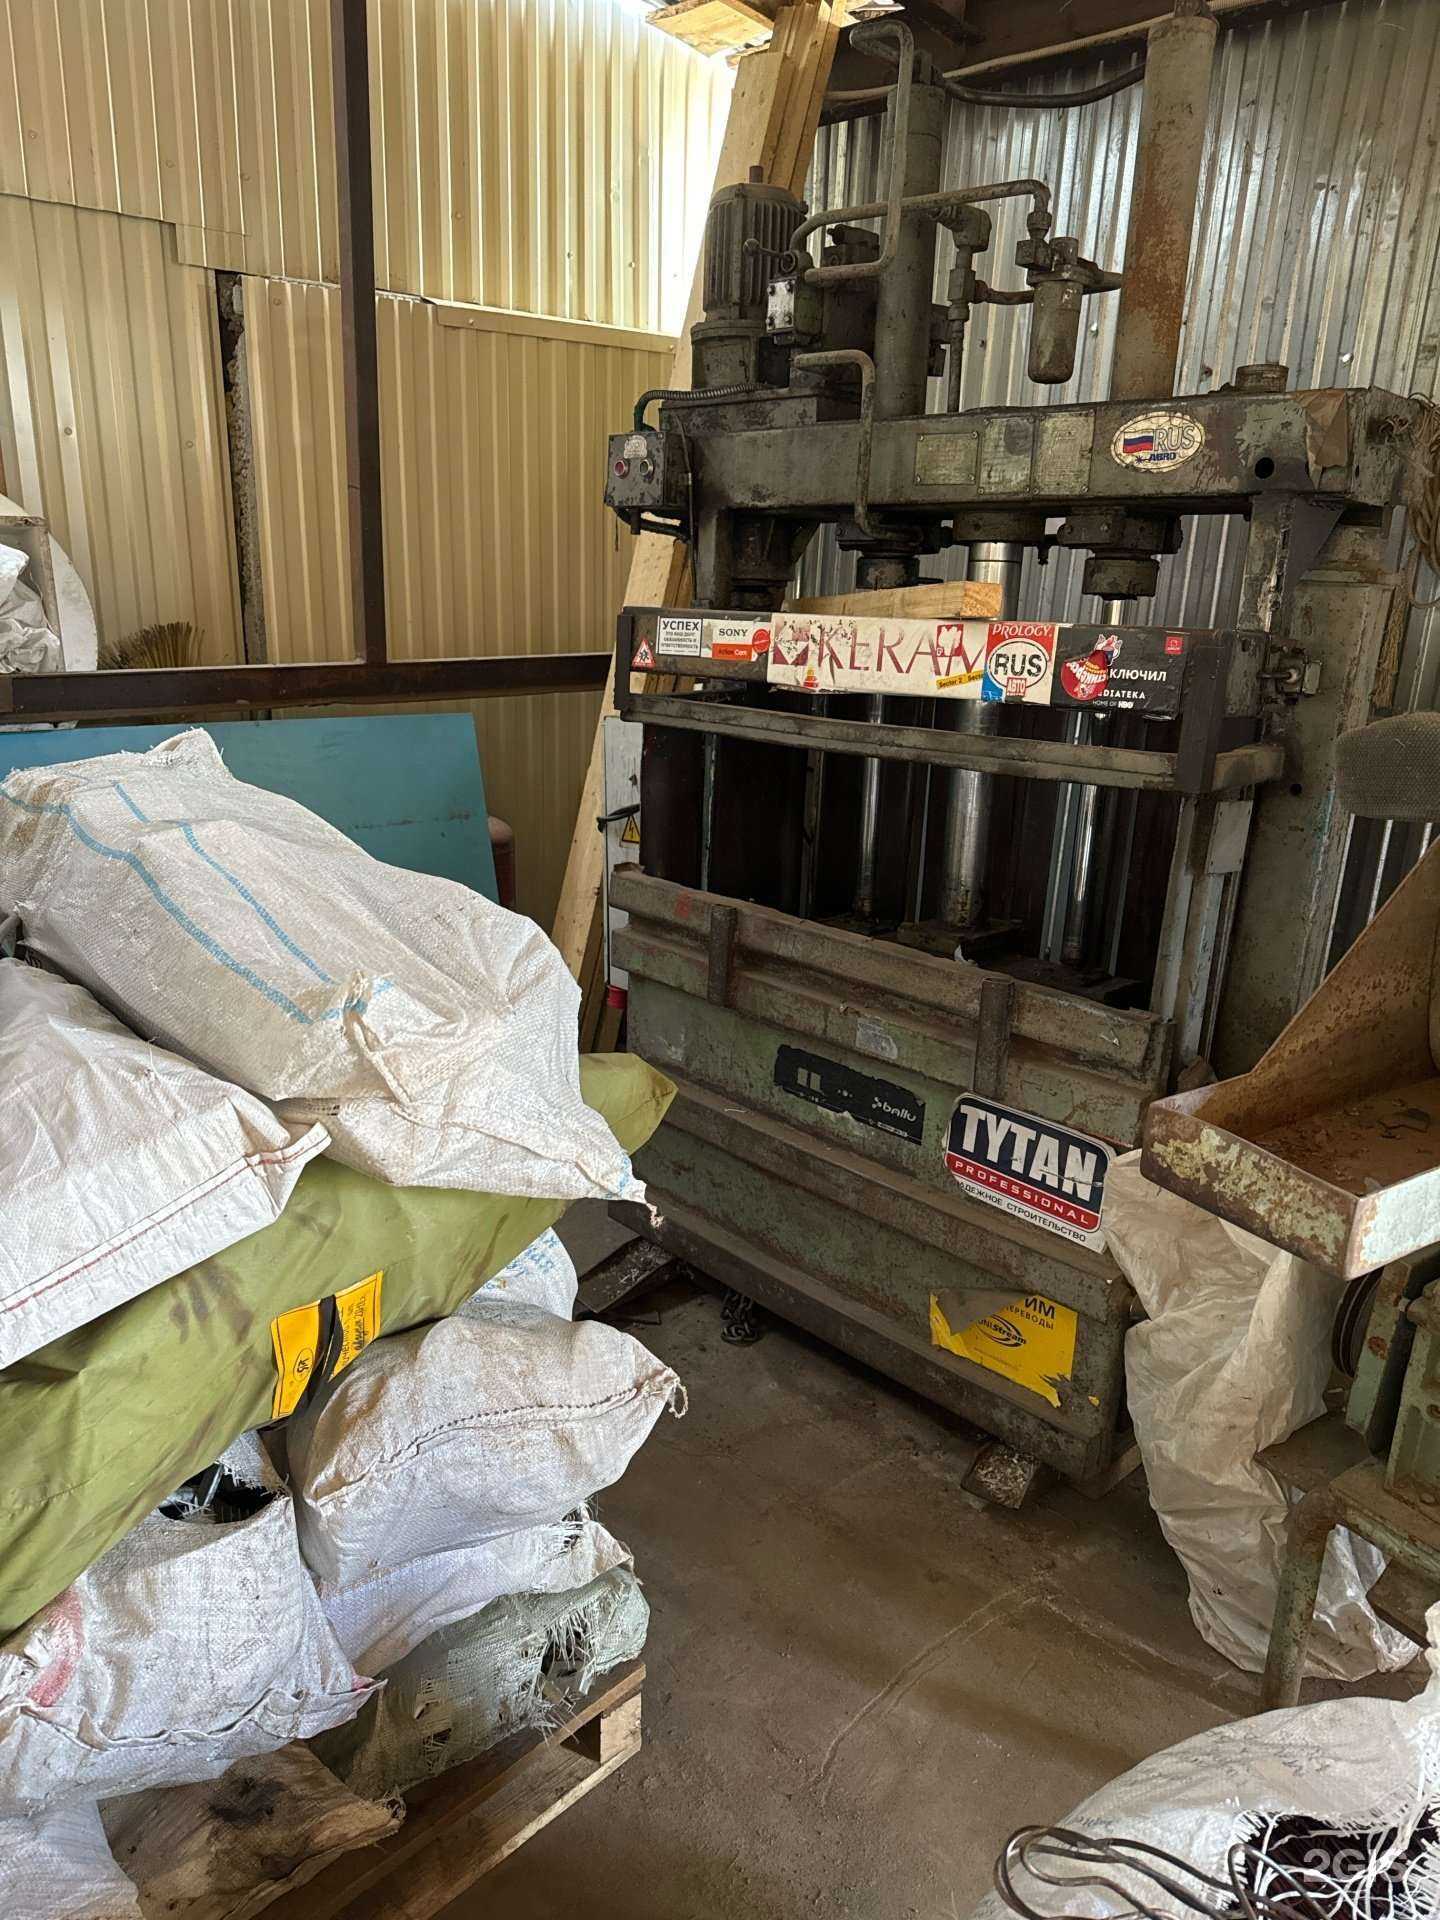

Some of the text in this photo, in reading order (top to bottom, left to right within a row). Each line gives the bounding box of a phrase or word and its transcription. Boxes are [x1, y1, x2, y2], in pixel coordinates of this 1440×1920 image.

[1153, 425, 1196, 452] RUS
[662, 619, 700, 631] УСПЕХ
[718, 628, 749, 637] SONY
[993, 653, 1042, 677] RUS
[1109, 668, 1167, 682] КЛЮЧИЛ
[882, 1101, 917, 1122] ballu
[960, 1104, 1098, 1202] TYTAN
[955, 1161, 1089, 1225] PROFESSIONAL
[1006, 1202, 1087, 1242] СТРОИТЕЛЬСТВО
